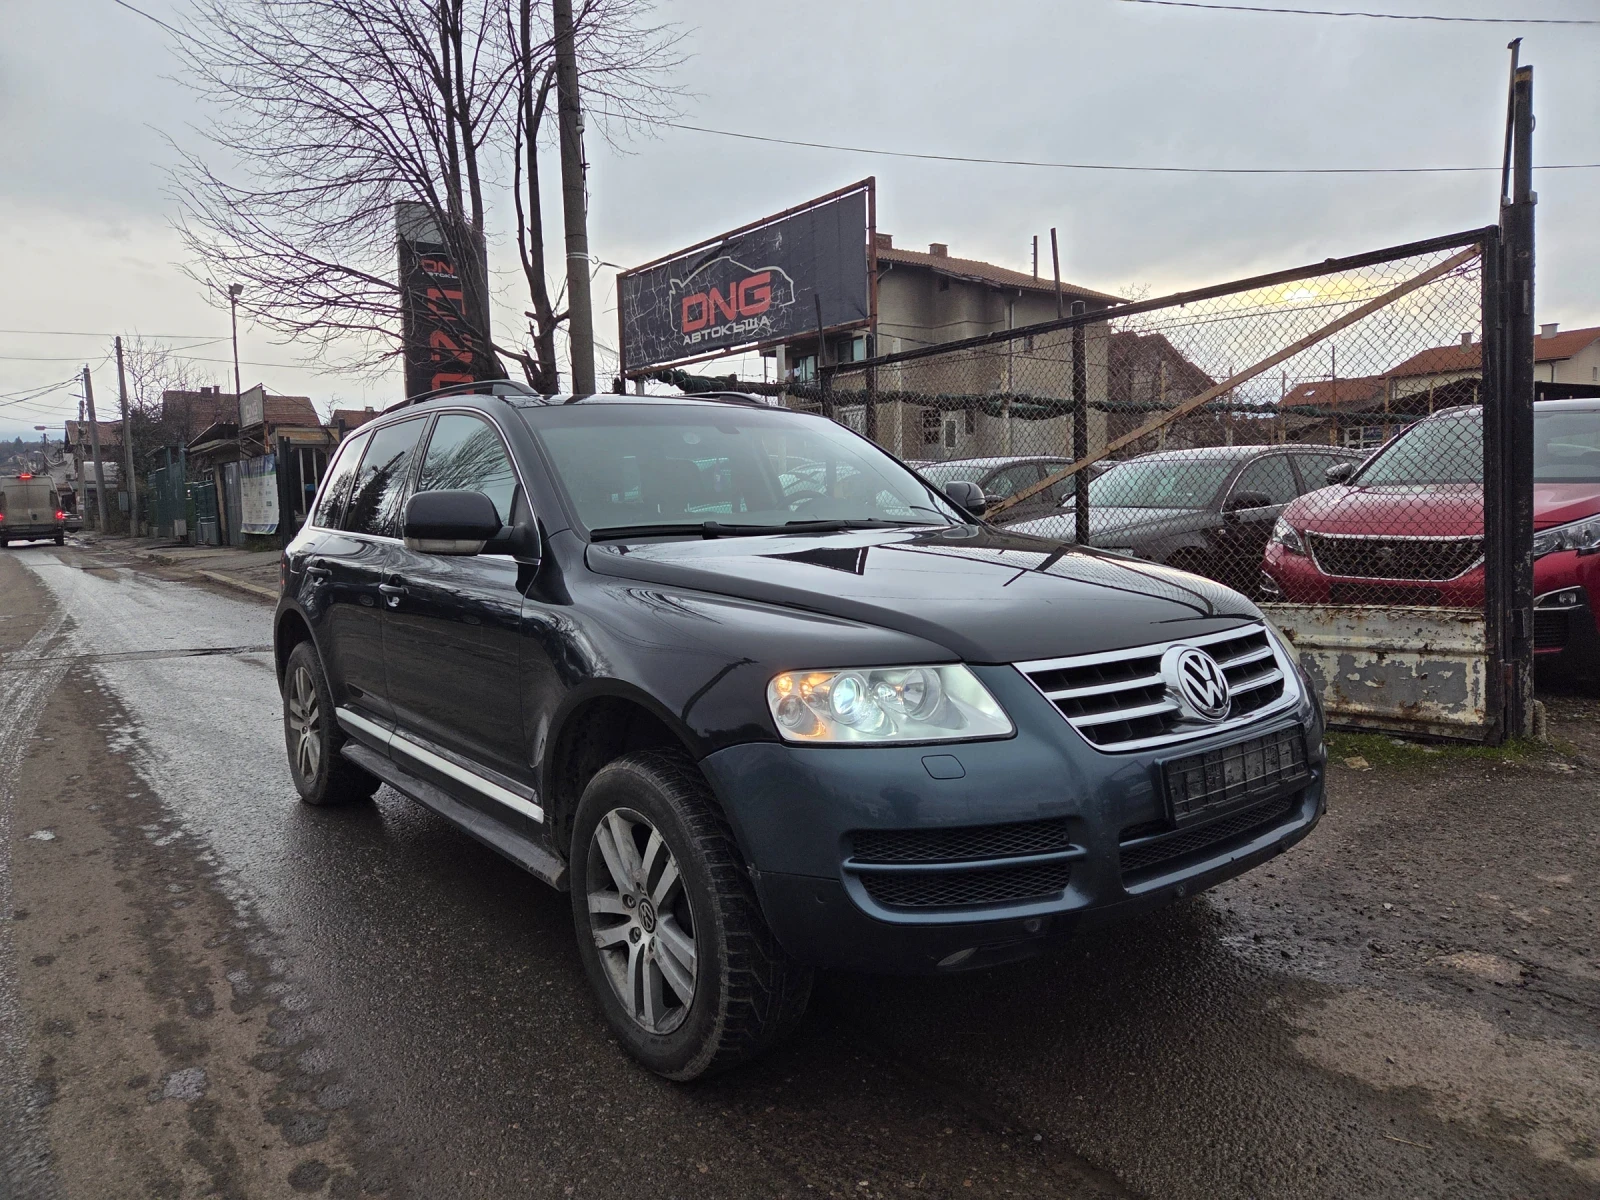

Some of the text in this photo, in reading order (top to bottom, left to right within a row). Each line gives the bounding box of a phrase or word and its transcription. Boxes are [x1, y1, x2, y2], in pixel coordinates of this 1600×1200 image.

[421, 259, 454, 274] DN
[682, 271, 771, 333] DNG
[1180, 652, 1227, 714] VW
